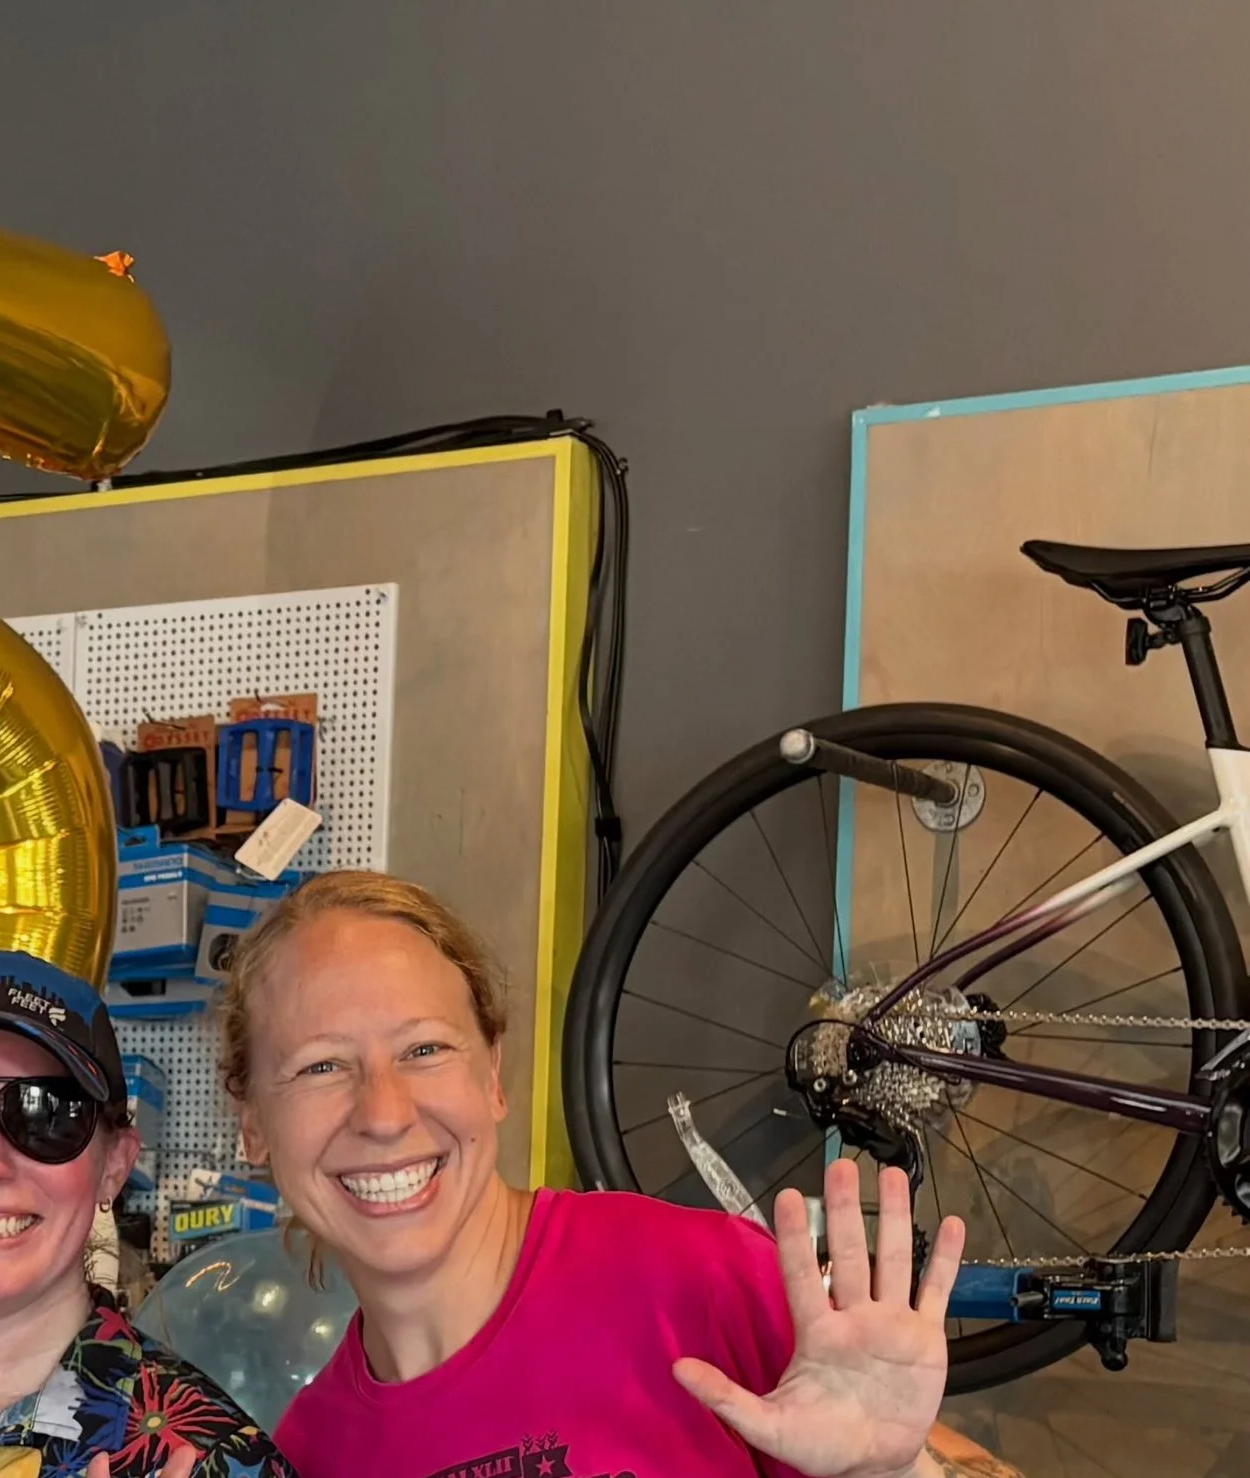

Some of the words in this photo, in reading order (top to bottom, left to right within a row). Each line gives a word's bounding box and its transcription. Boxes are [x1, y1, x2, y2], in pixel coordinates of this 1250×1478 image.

[8, 987, 51, 1011] FLEET
[11, 995, 46, 1015] FEET
[174, 1203, 235, 1233] OURY
